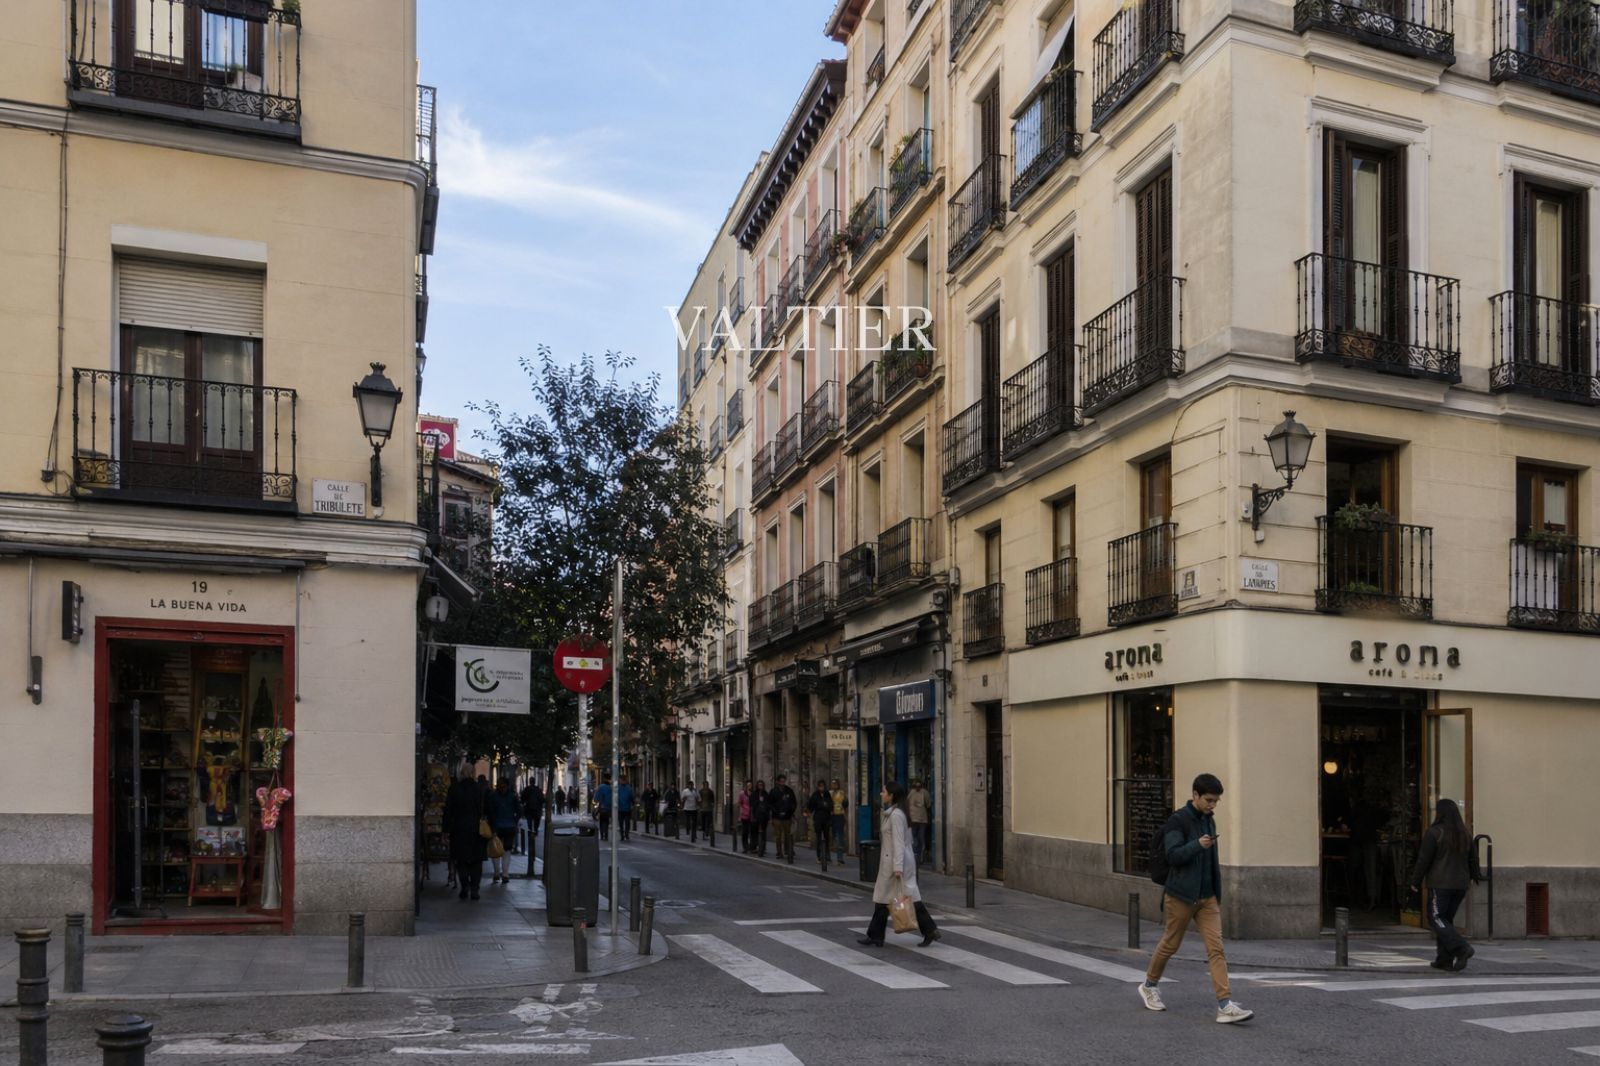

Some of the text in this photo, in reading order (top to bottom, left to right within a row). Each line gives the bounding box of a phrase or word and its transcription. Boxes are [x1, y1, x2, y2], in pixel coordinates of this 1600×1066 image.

[315, 500, 364, 514] TRIBULETE
[192, 581, 208, 593] 19
[150, 599, 247, 613] LA BUENA VIDA
